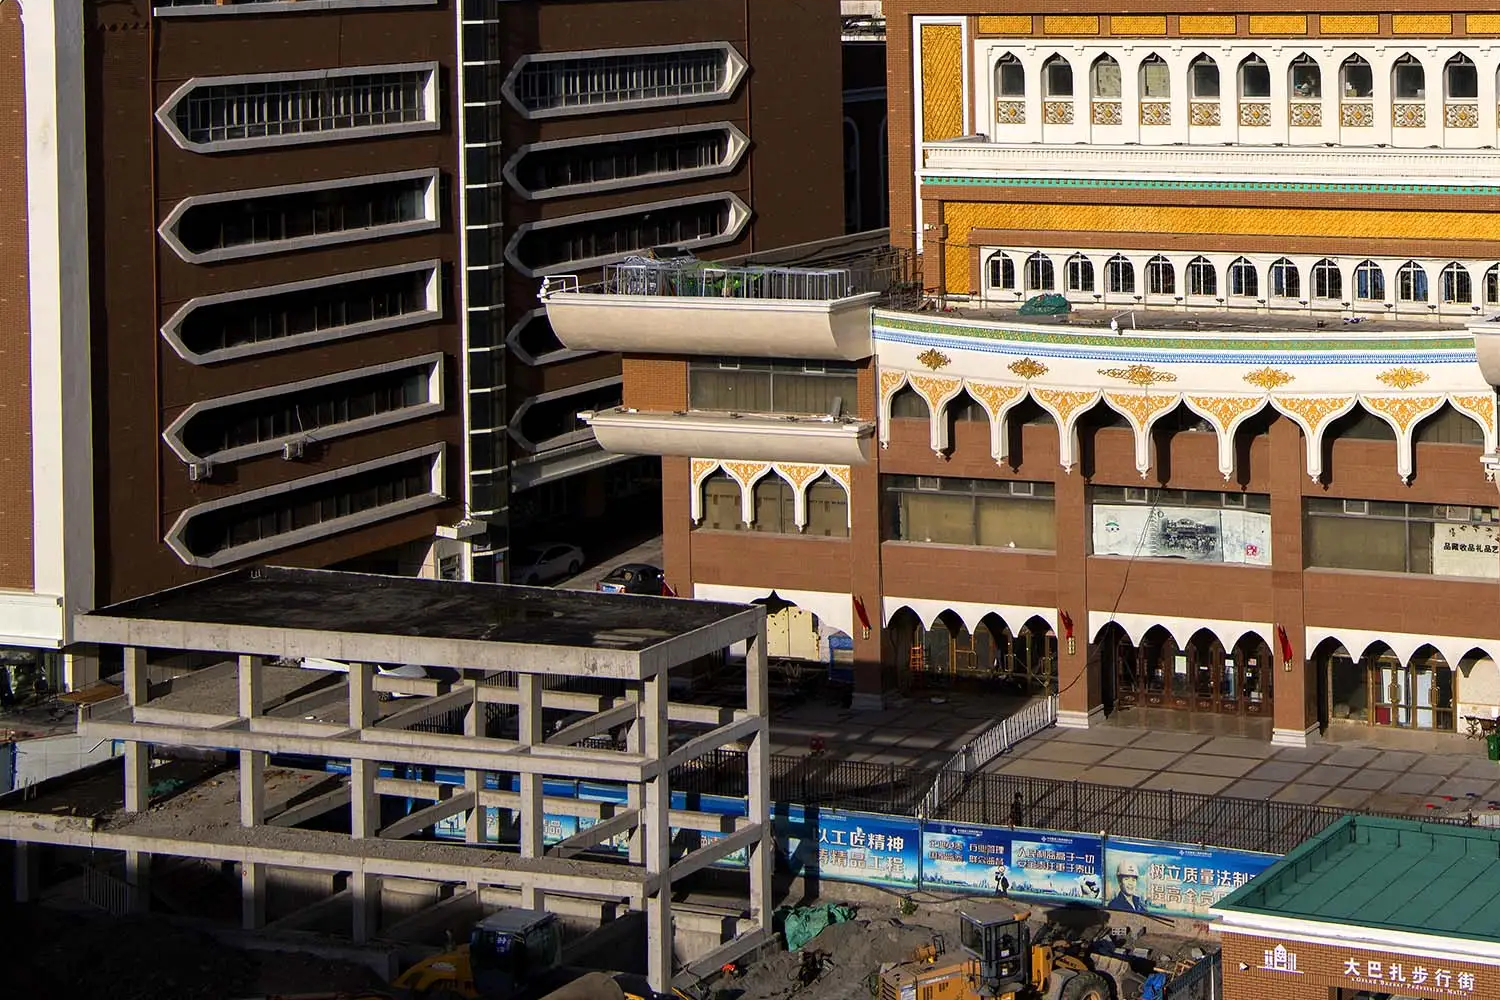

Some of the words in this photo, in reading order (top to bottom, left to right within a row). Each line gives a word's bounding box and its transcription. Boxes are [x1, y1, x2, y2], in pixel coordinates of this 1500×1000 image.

[813, 826, 904, 853] 以工匠精神
[1017, 847, 1095, 864] 人民利益高于一切
[1150, 863, 1256, 888] 树立质量法制
[1344, 958, 1475, 991] 大巴扎步行街
